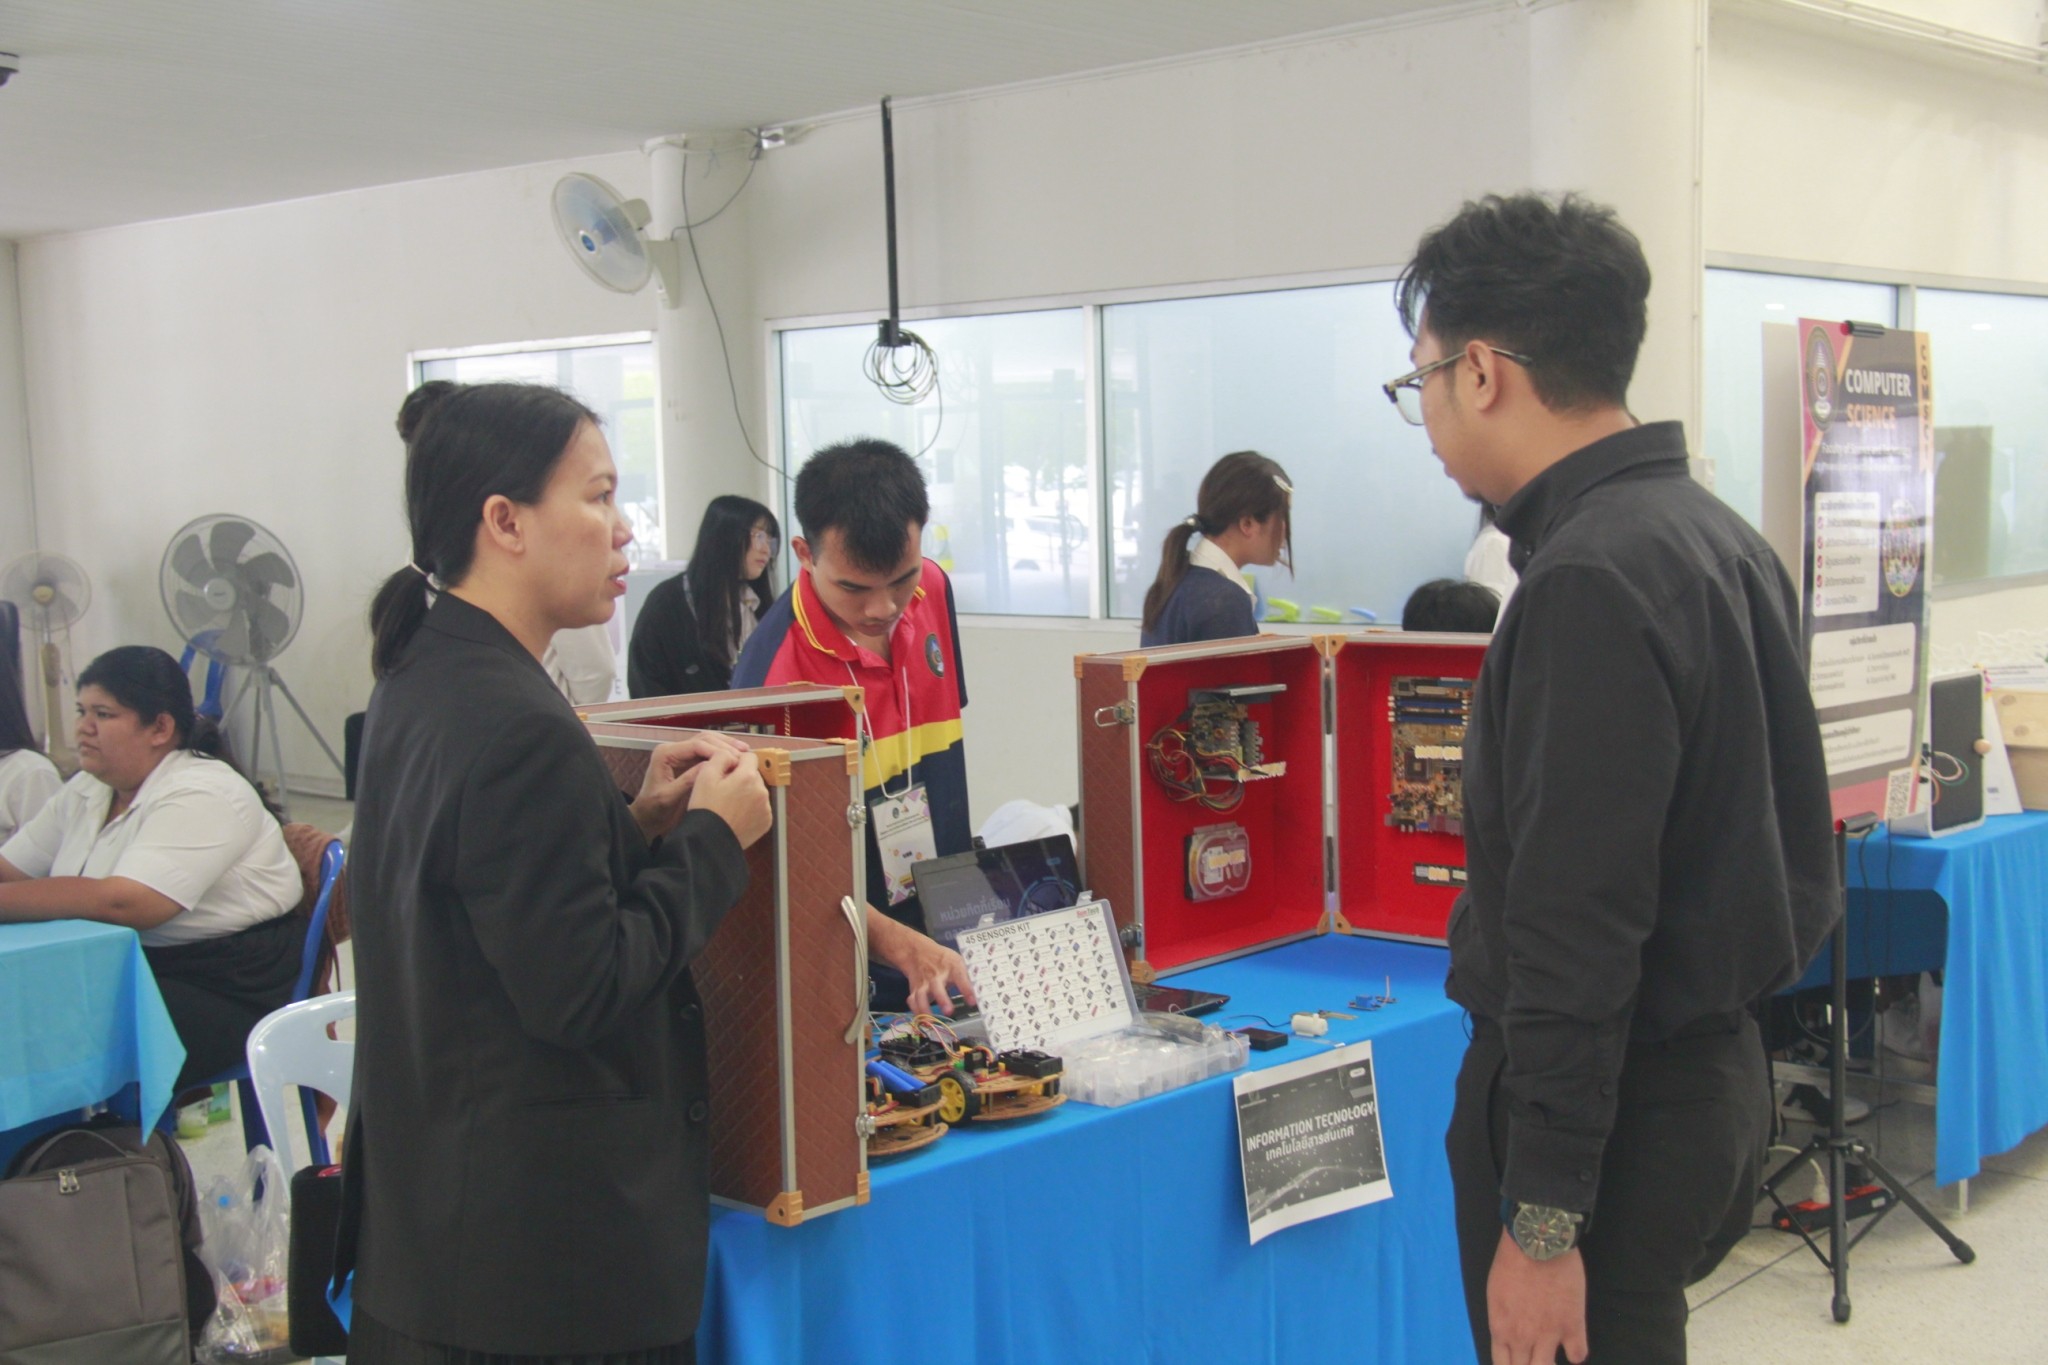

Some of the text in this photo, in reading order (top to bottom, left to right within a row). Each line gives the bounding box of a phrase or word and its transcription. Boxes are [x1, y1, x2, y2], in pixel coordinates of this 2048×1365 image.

[1845, 368, 1912, 398] COMPUTER
[1847, 402, 1897, 430] SCIENCE
[965, 922, 1031, 945] 45 SENSORS KIT
[1246, 1101, 1375, 1153] INFORMATION TECNOLOGY
